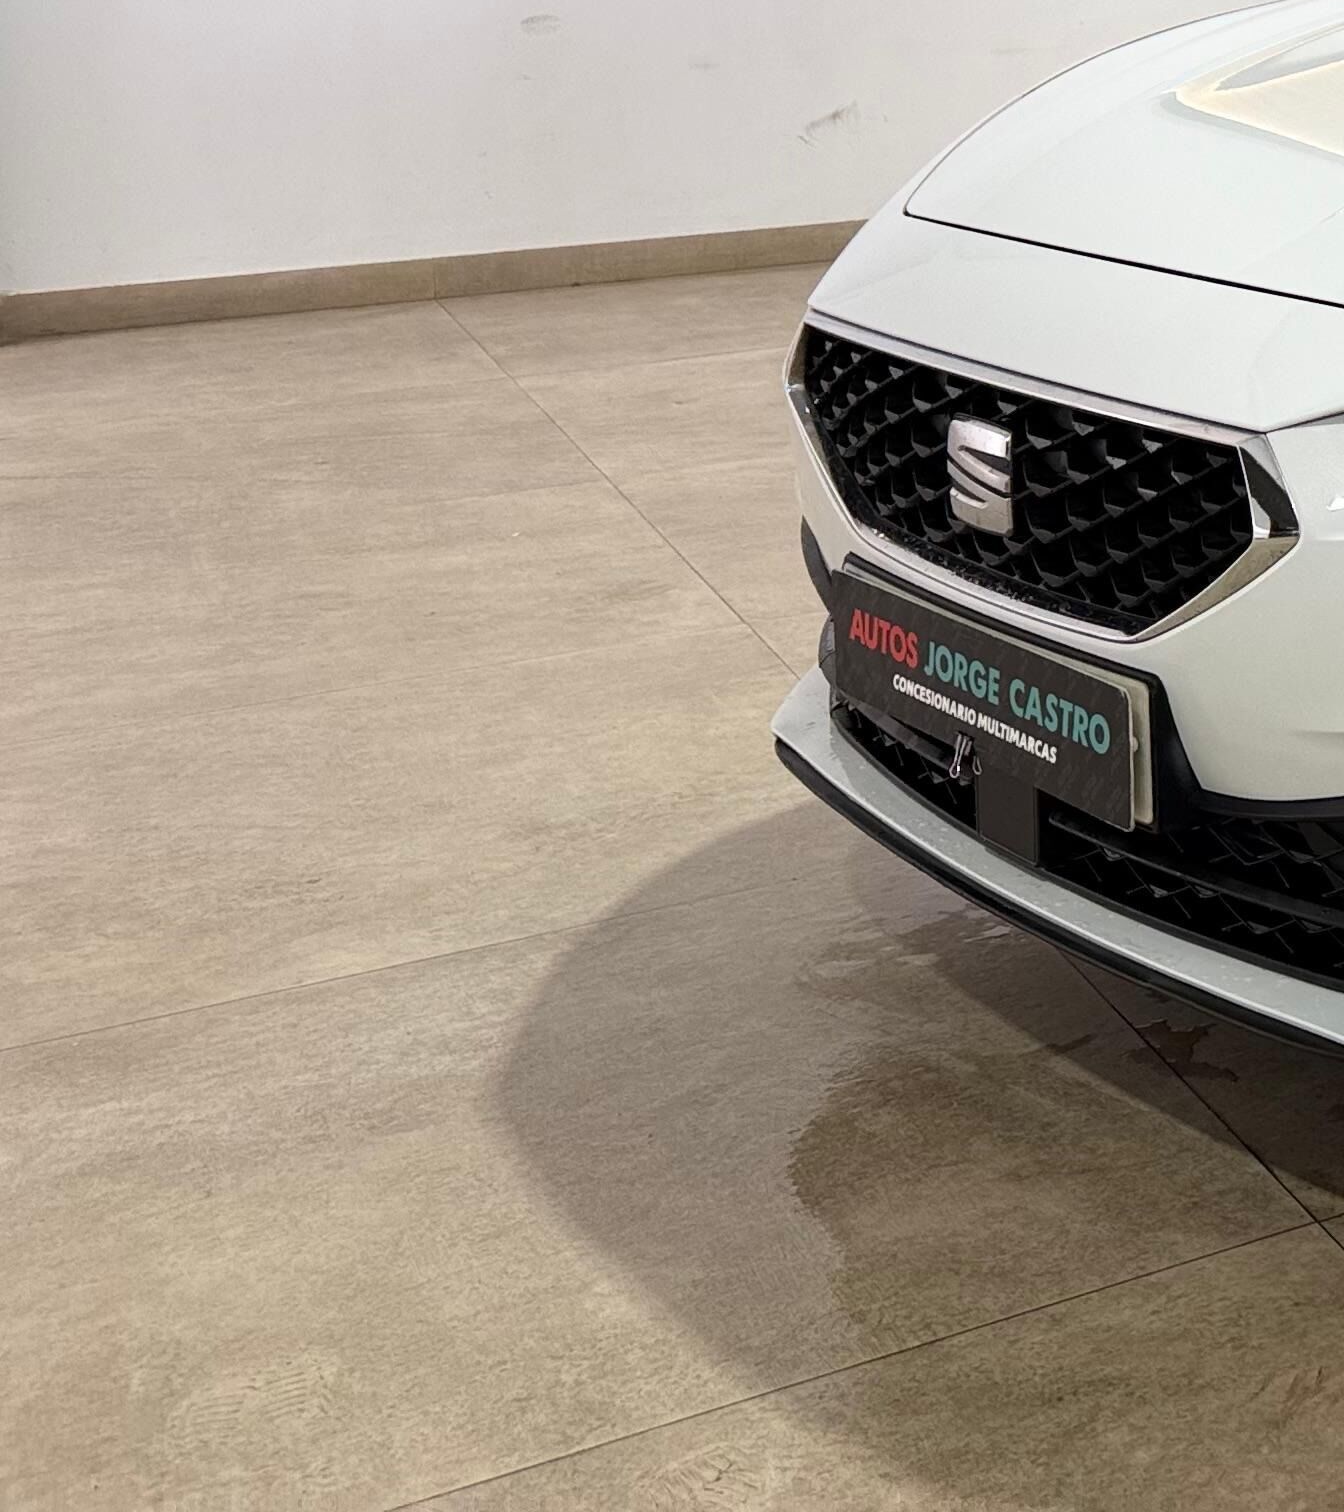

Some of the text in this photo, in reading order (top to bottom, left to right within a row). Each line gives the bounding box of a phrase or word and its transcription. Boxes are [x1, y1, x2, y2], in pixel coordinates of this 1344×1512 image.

[849, 609, 1110, 754] AUTOS JORGE CASTRO
[893, 673, 1057, 764] CONCESIONARIO MULTIMARCAS
